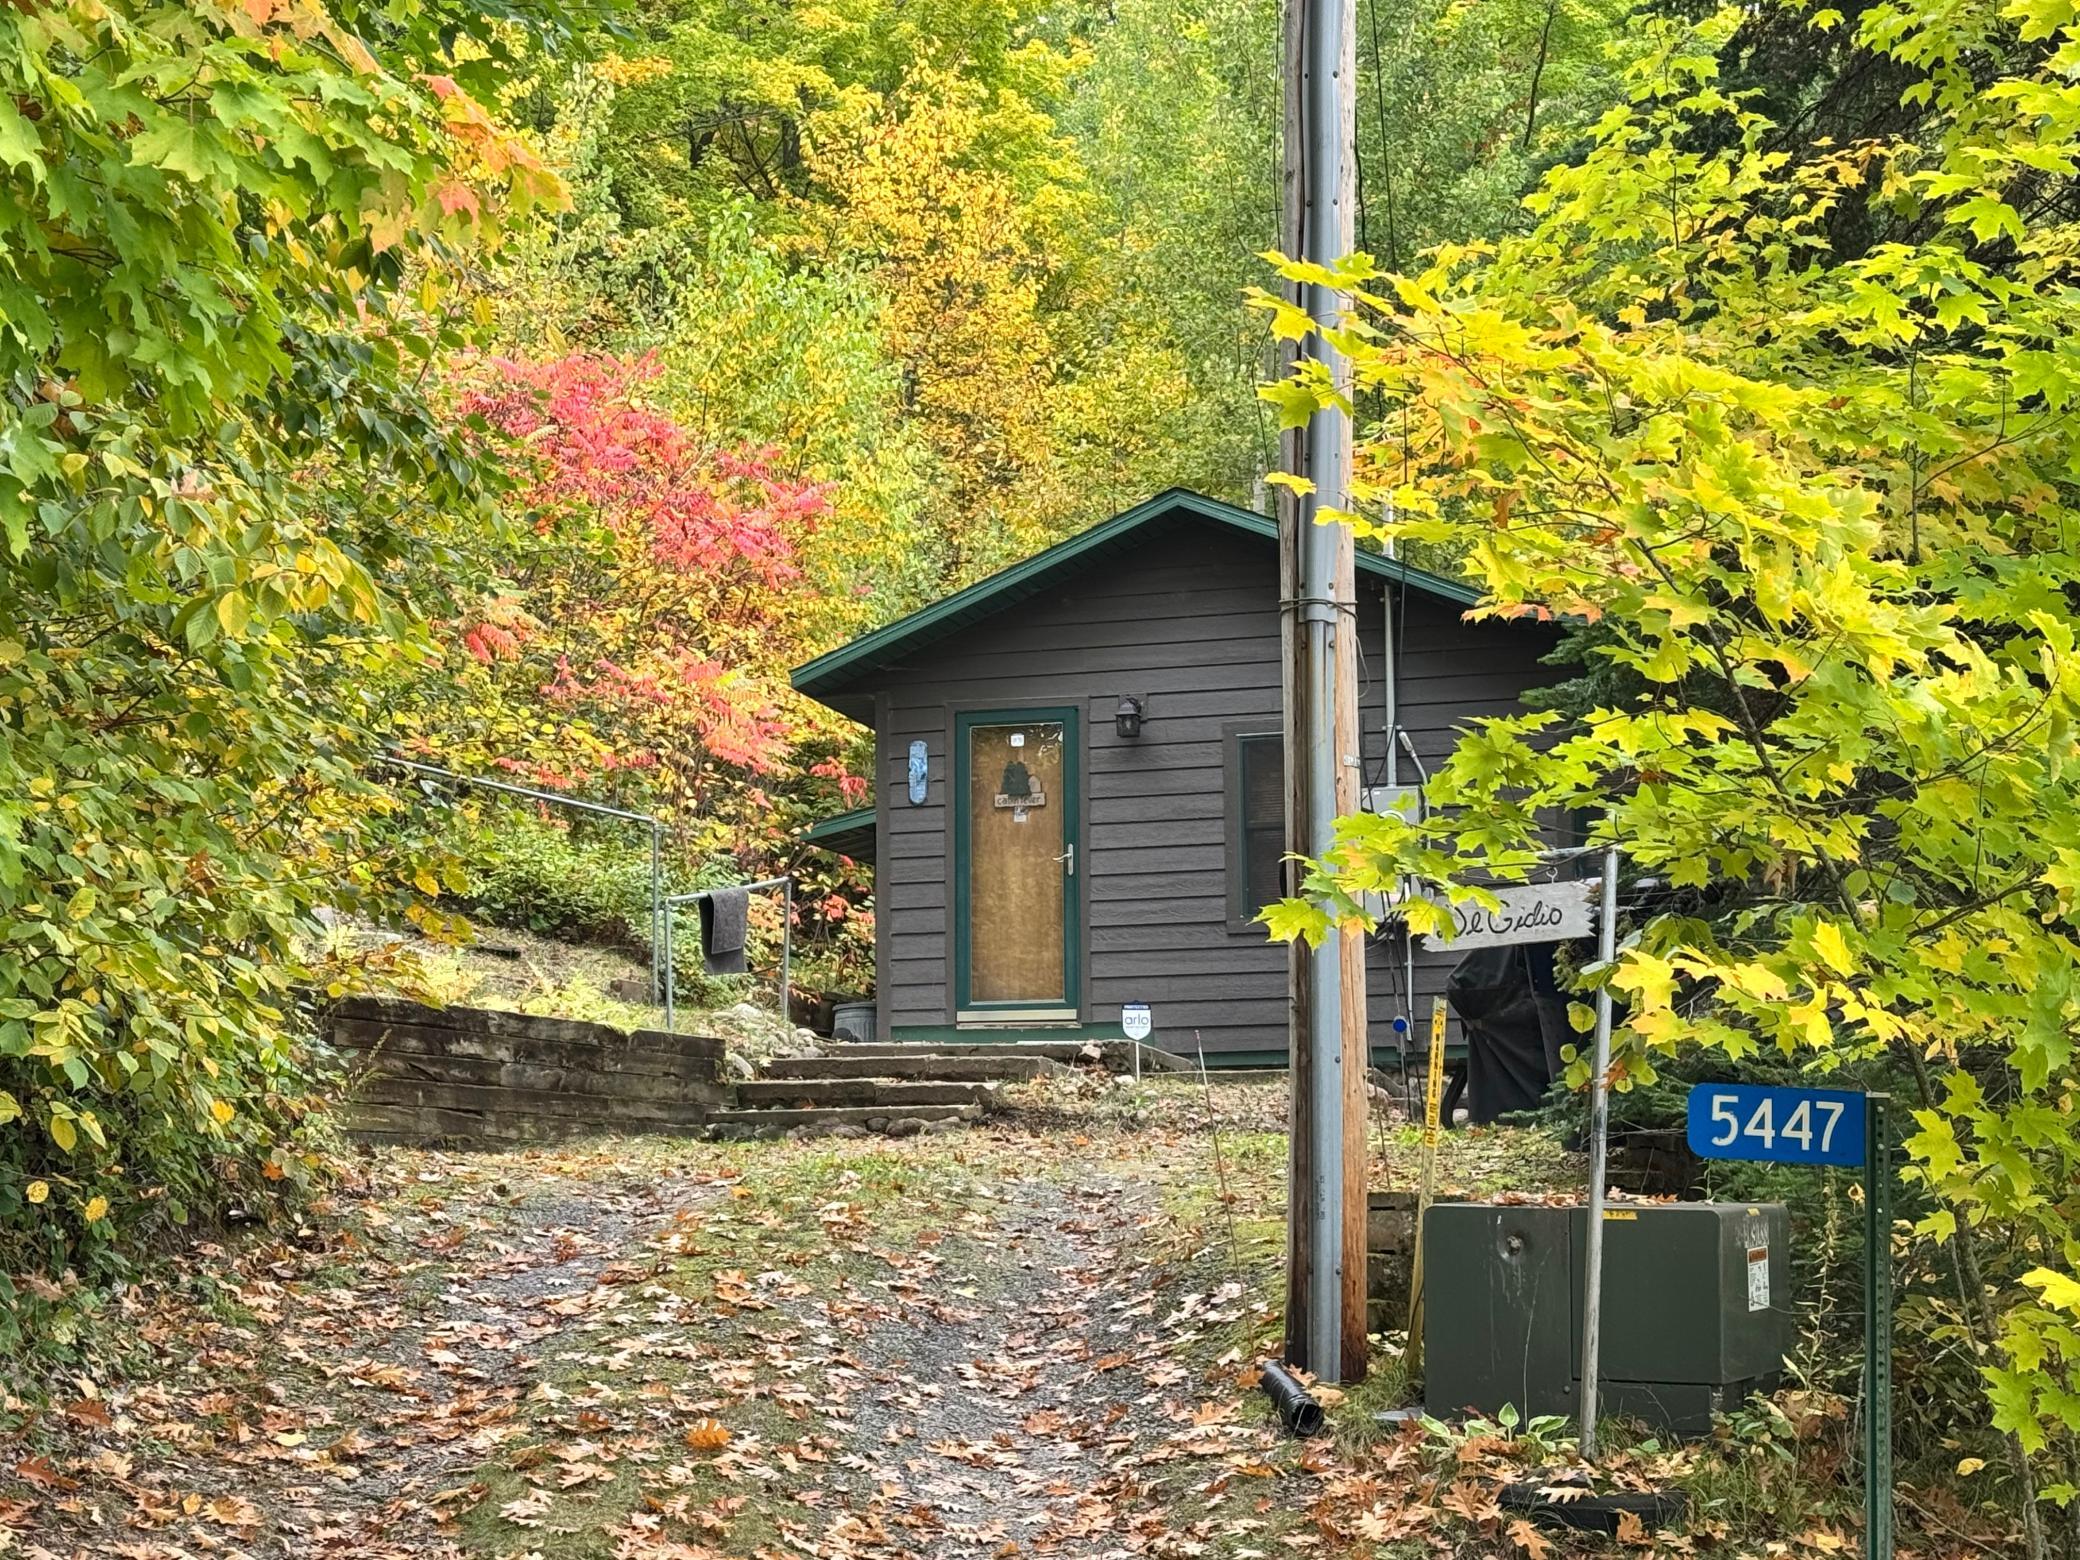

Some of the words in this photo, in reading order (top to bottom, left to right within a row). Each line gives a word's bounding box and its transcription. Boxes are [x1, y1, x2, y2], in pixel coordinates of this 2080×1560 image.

[1488, 900, 1562, 934] Gidio
[1124, 1013, 1149, 1025] arlo
[1711, 1094, 1845, 1152] 5447
